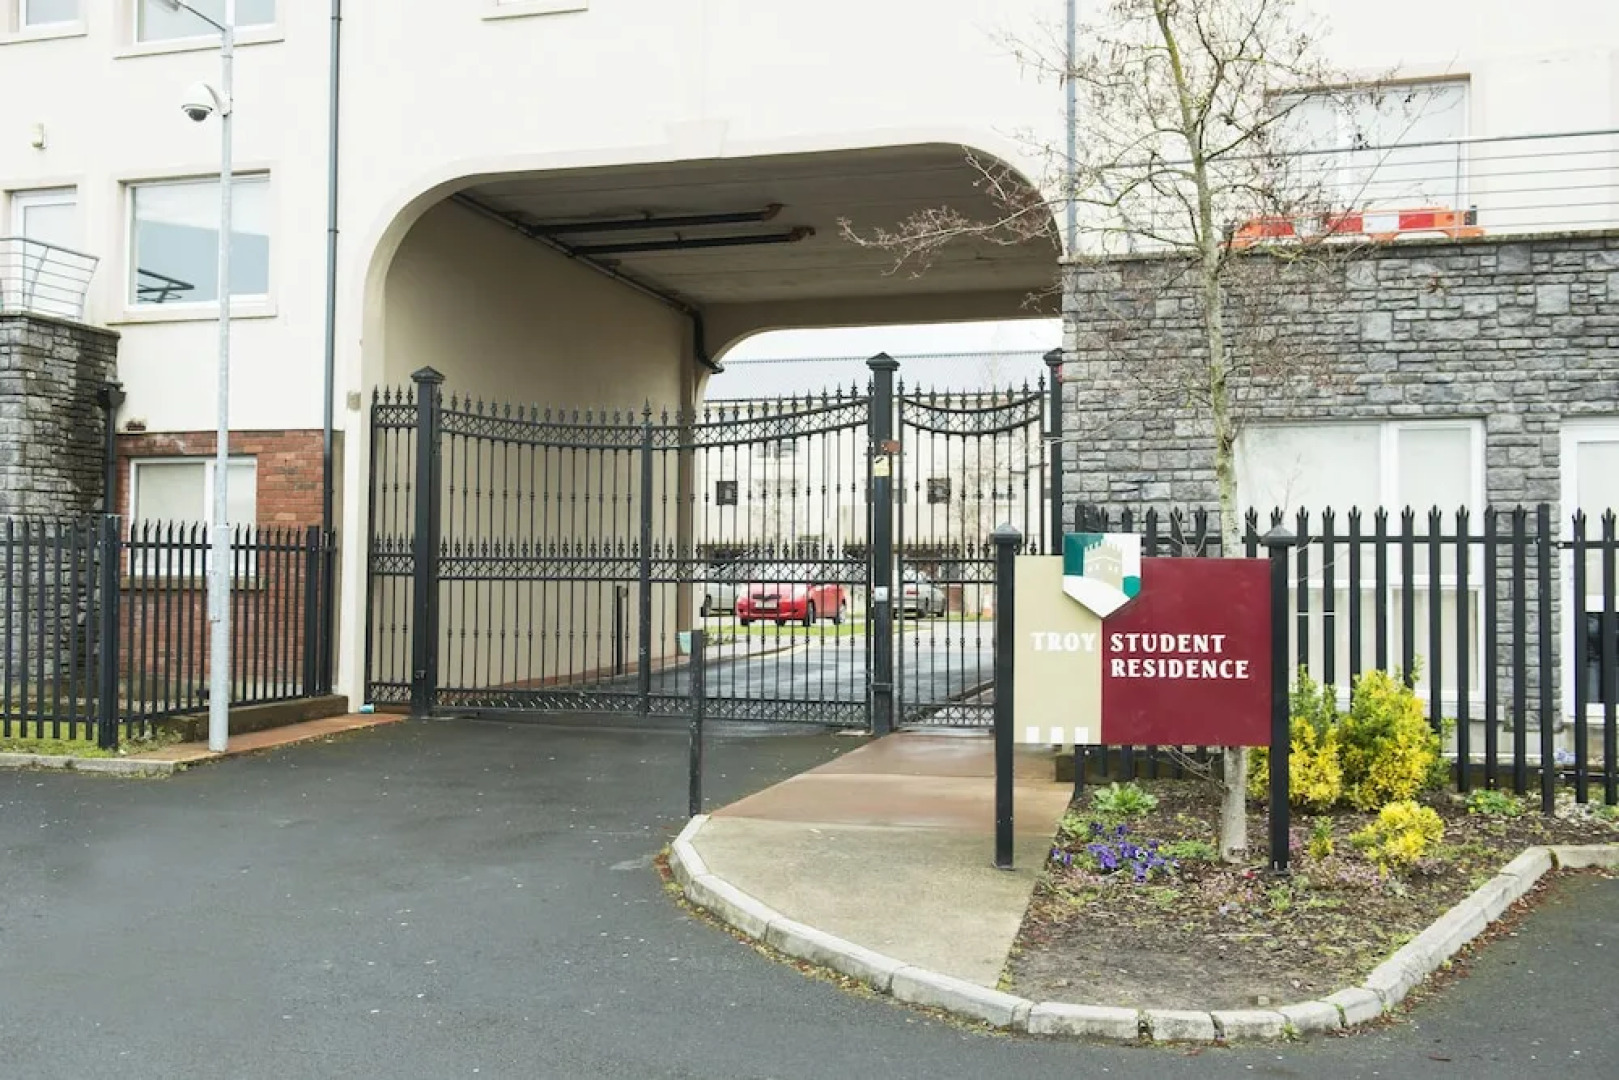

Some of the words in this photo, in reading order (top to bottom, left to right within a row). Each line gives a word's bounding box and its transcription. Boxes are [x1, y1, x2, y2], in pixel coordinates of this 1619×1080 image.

[1030, 632, 1097, 651] TROY
[1110, 633, 1226, 653] STUDENT
[1110, 658, 1249, 679] RESIDENCE
